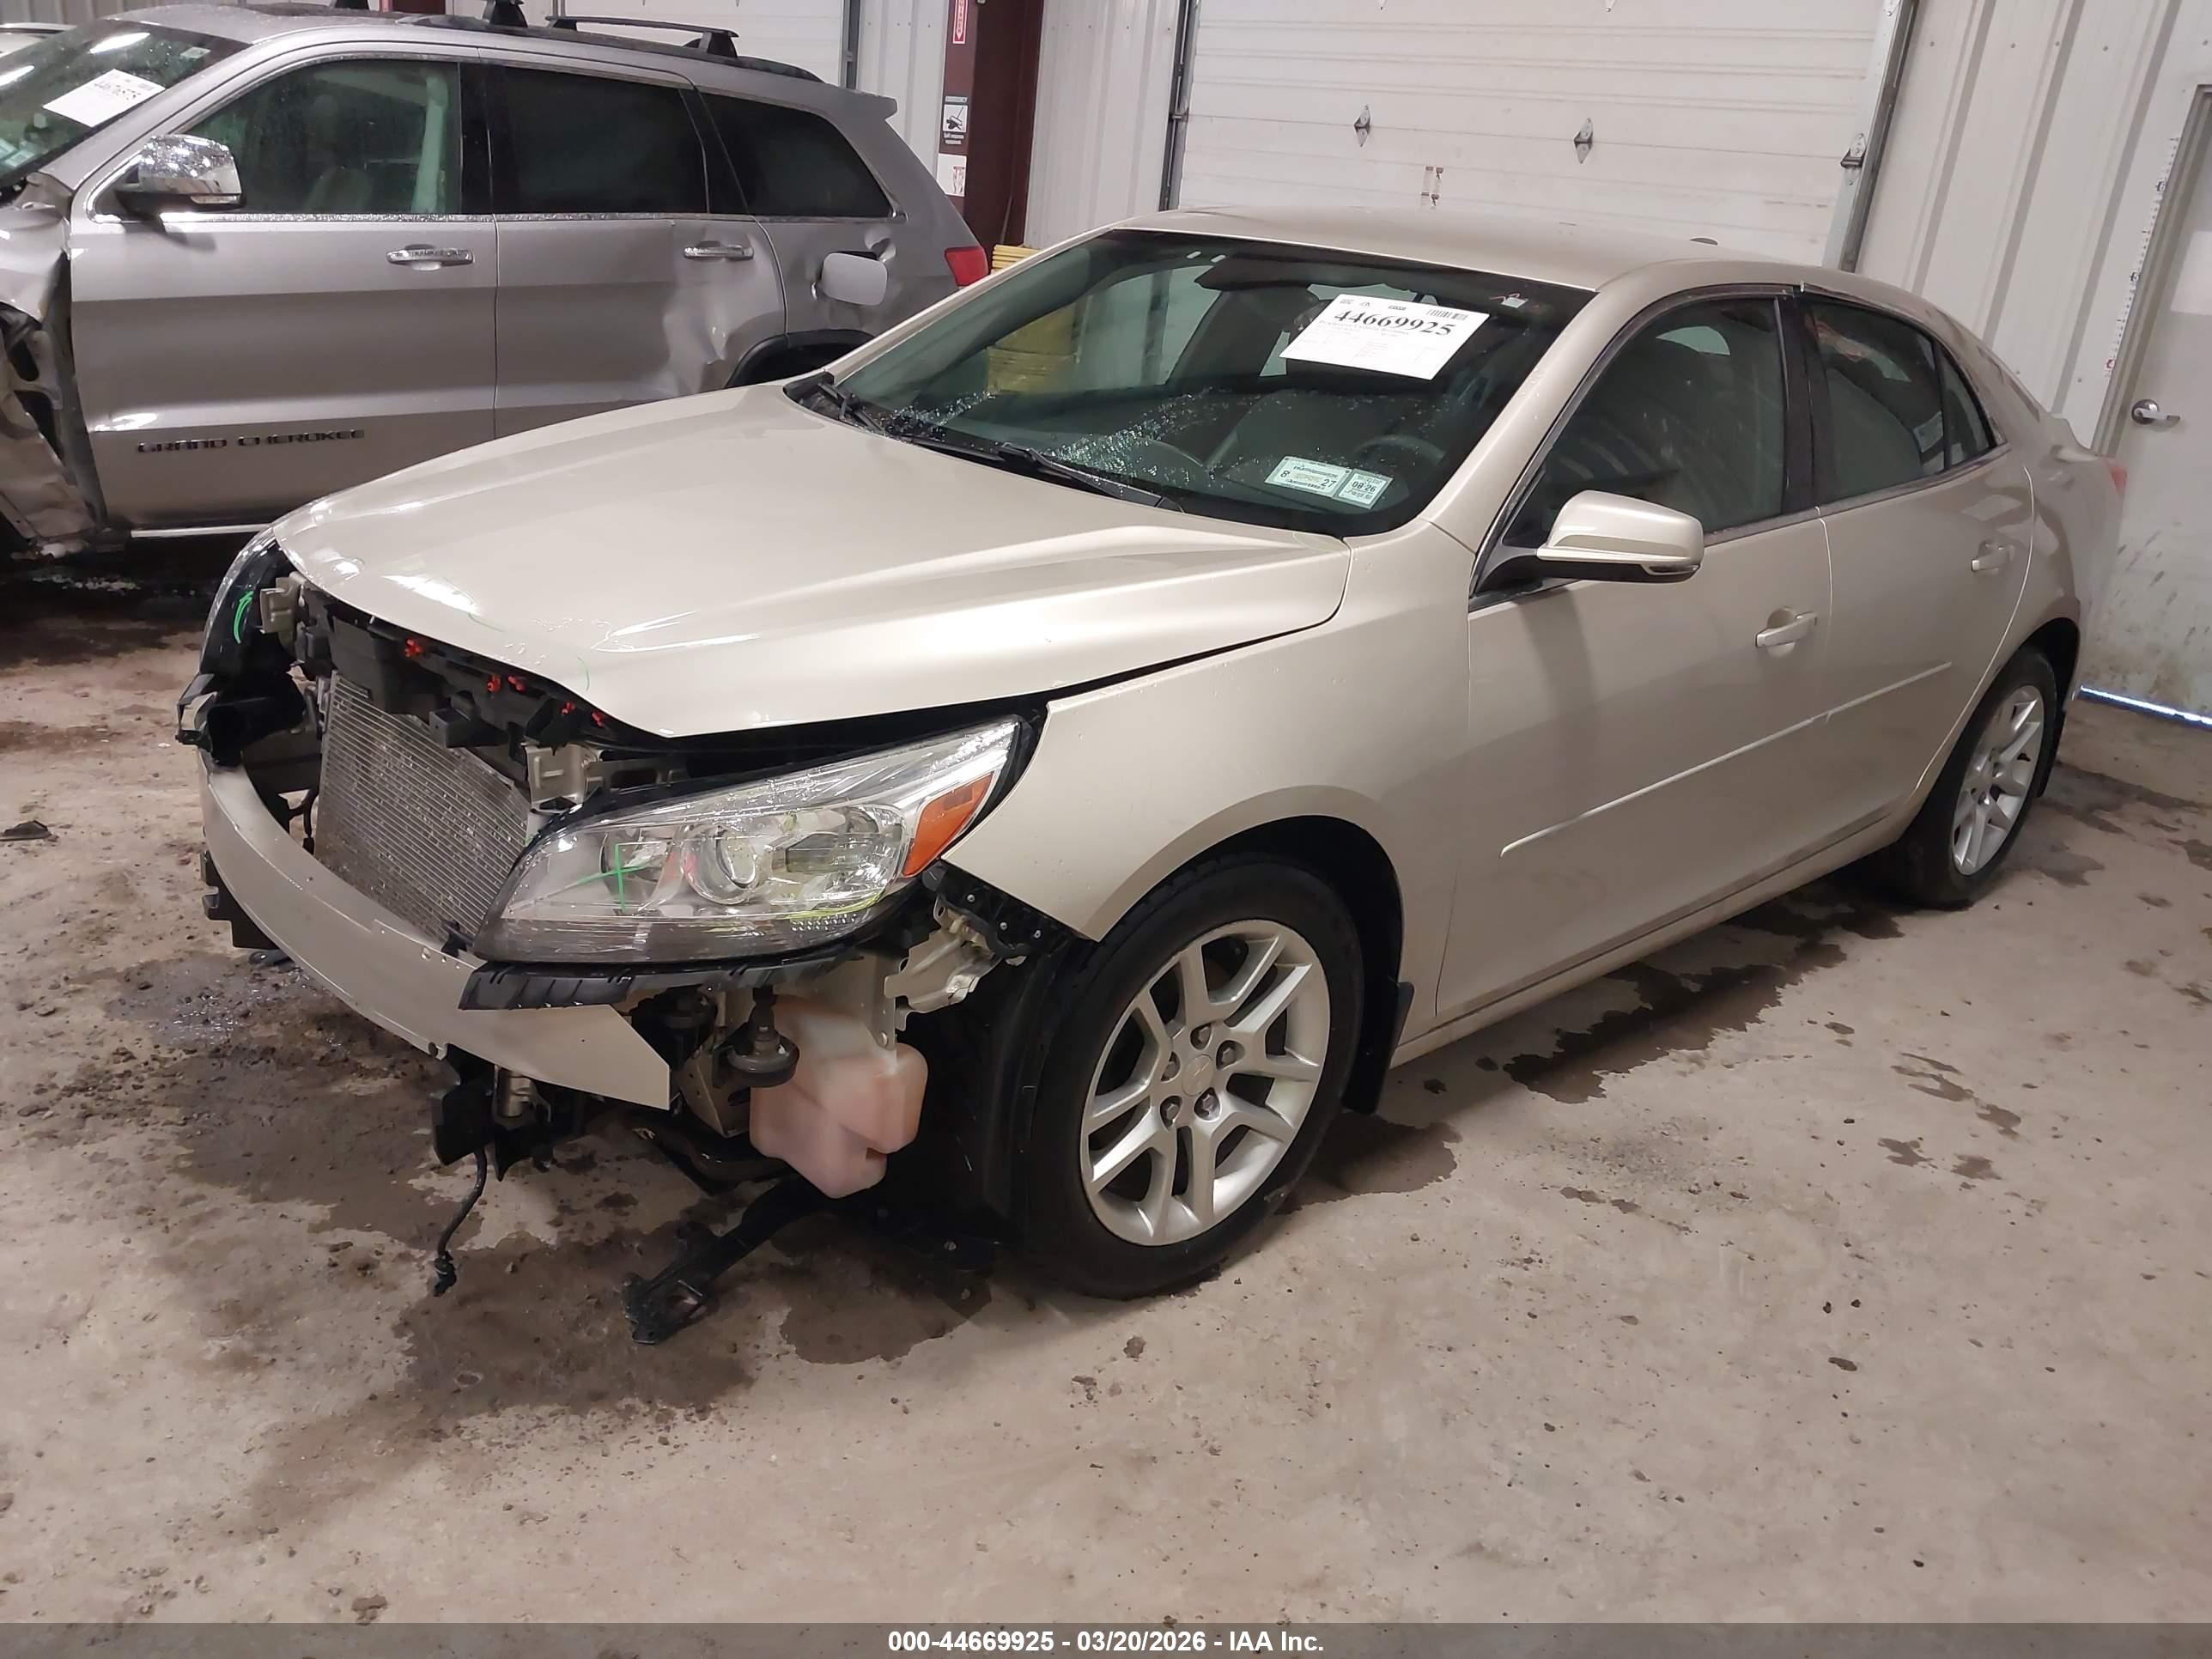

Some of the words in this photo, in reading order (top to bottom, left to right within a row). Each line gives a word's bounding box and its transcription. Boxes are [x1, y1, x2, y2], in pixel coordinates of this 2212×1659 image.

[1334, 310, 1456, 336] 44669925
[137, 439, 228, 453] GRAND
[237, 428, 365, 447] CHEROKEE
[1321, 478, 1337, 488] 27
